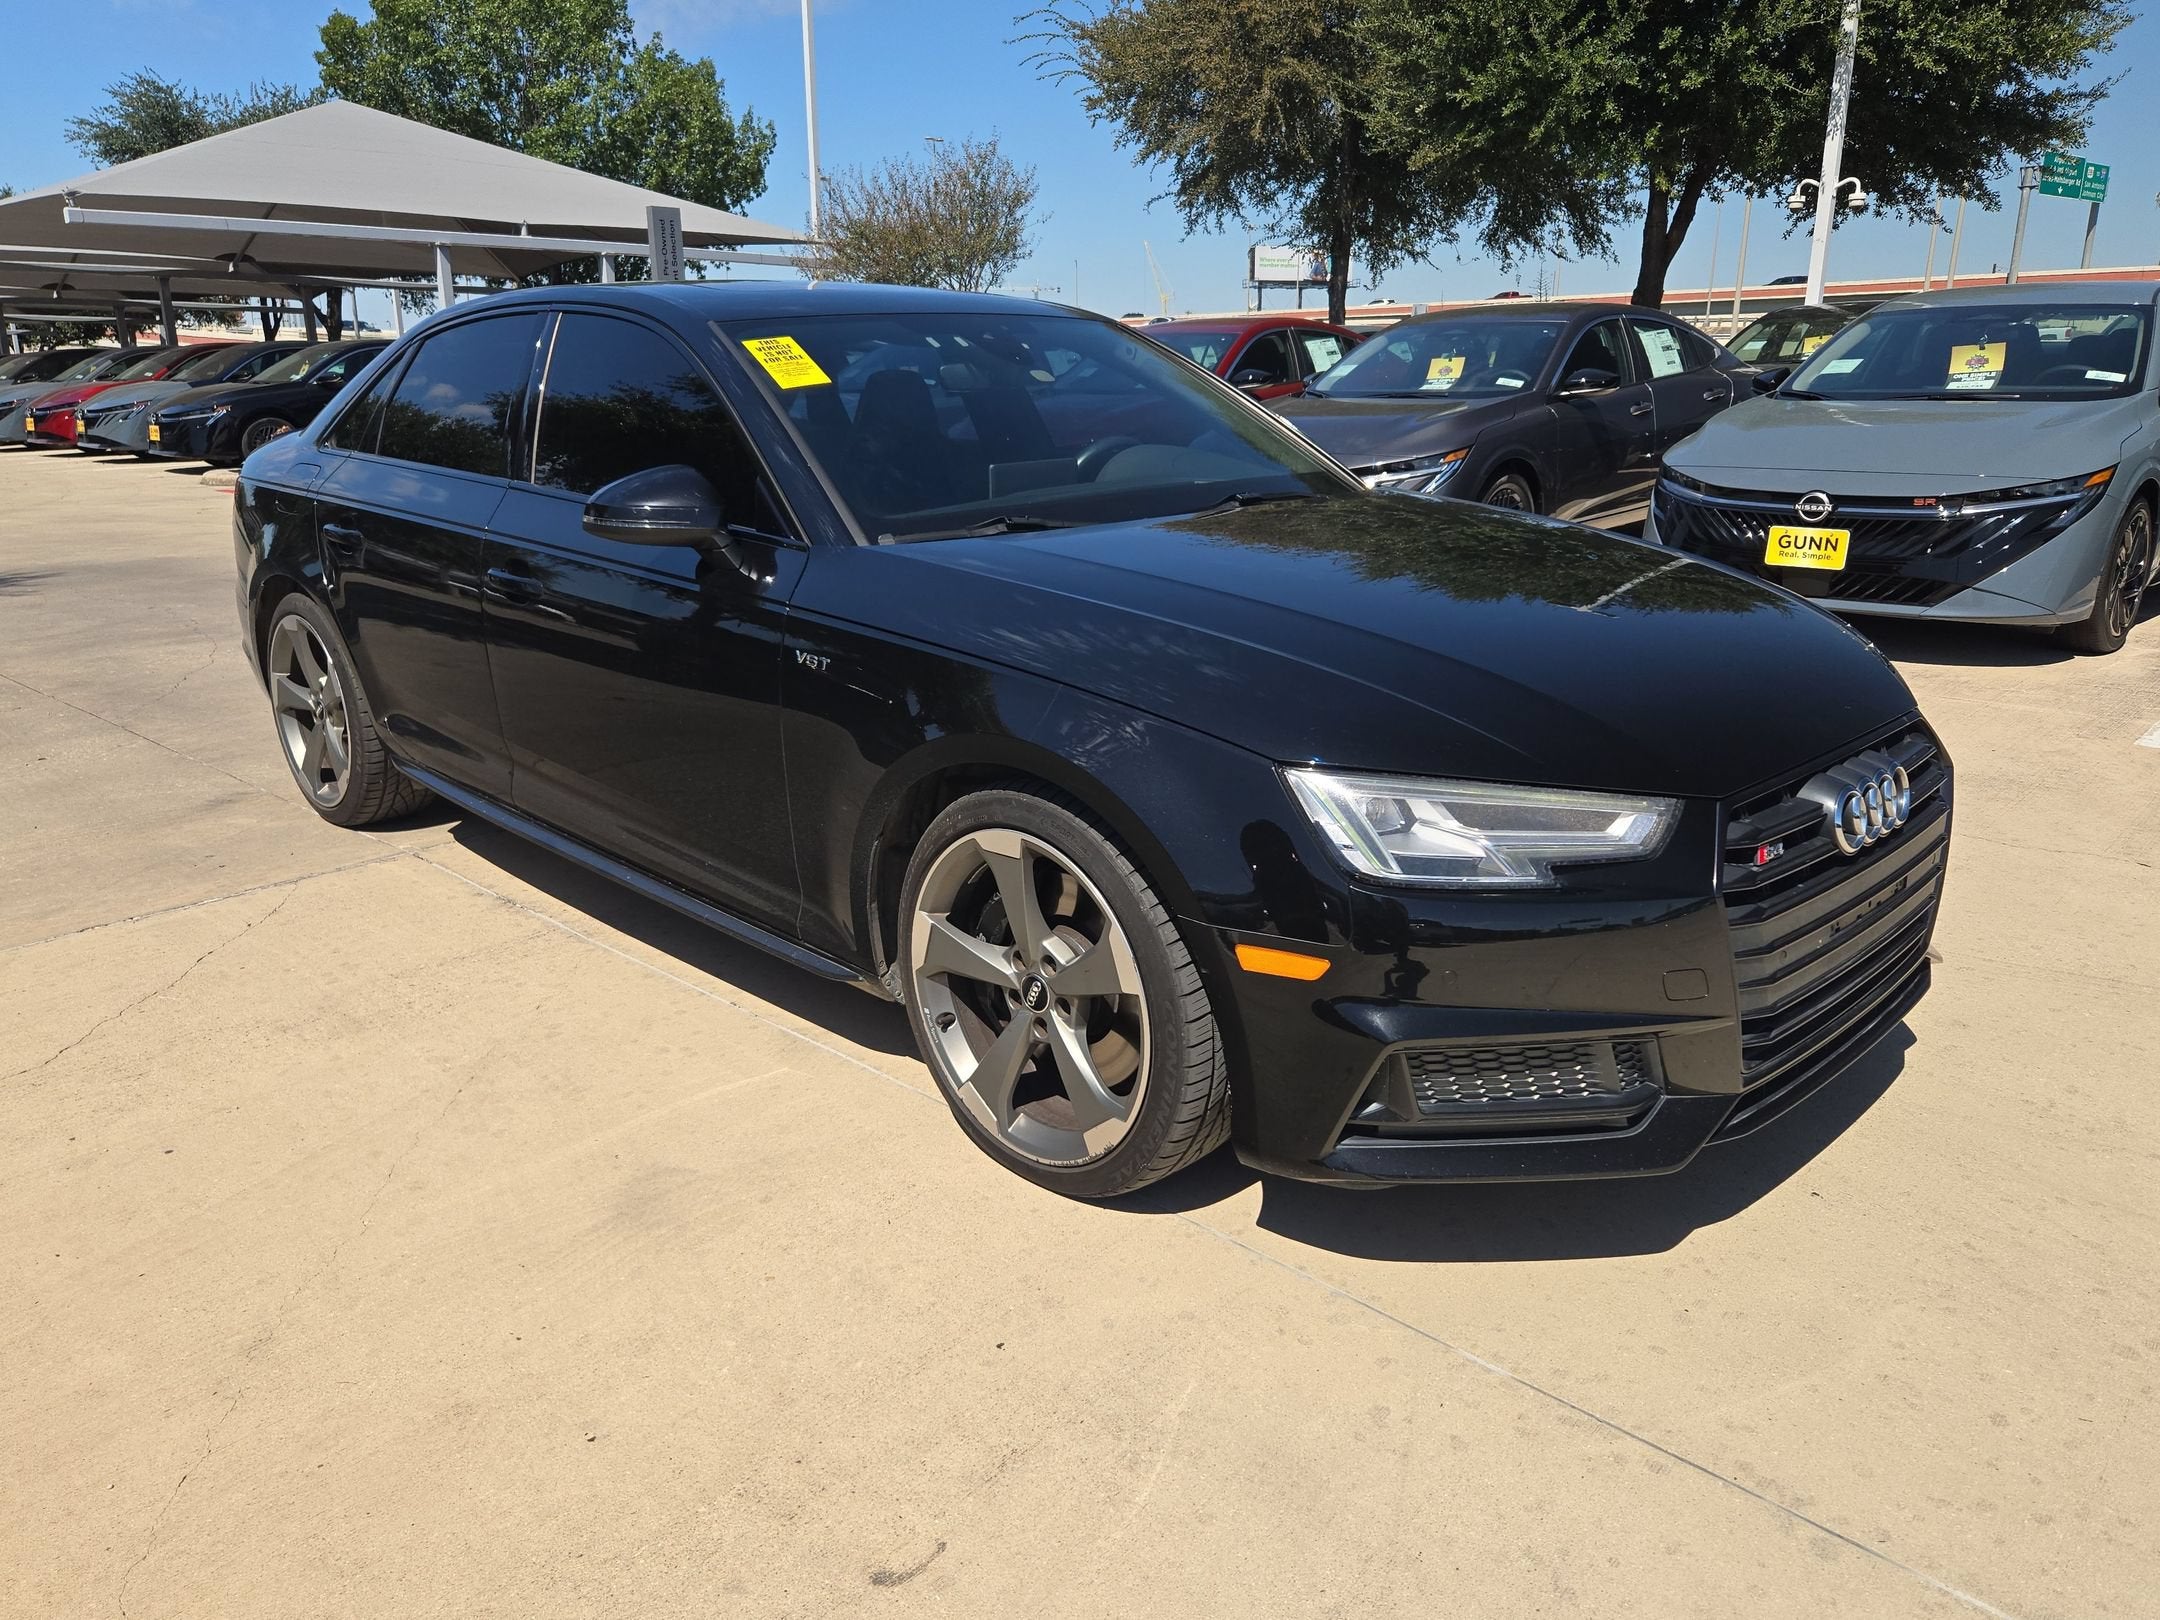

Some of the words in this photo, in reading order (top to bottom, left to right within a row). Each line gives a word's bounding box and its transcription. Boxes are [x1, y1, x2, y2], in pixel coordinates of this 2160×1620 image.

[660, 218, 670, 276] Pre-Owned
[669, 219, 679, 267] Selection
[755, 343, 792, 352] VEHICLE
[775, 349, 794, 357] NOT
[763, 356, 782, 364] FOR
[782, 354, 804, 362] SALE
[1913, 498, 1937, 506] SR
[1795, 503, 1833, 512] NISSAN
[1778, 534, 1839, 552] GUNN
[1778, 550, 1800, 559] Real.
[1802, 552, 1834, 561] Simple.
[796, 649, 831, 671] V6T
